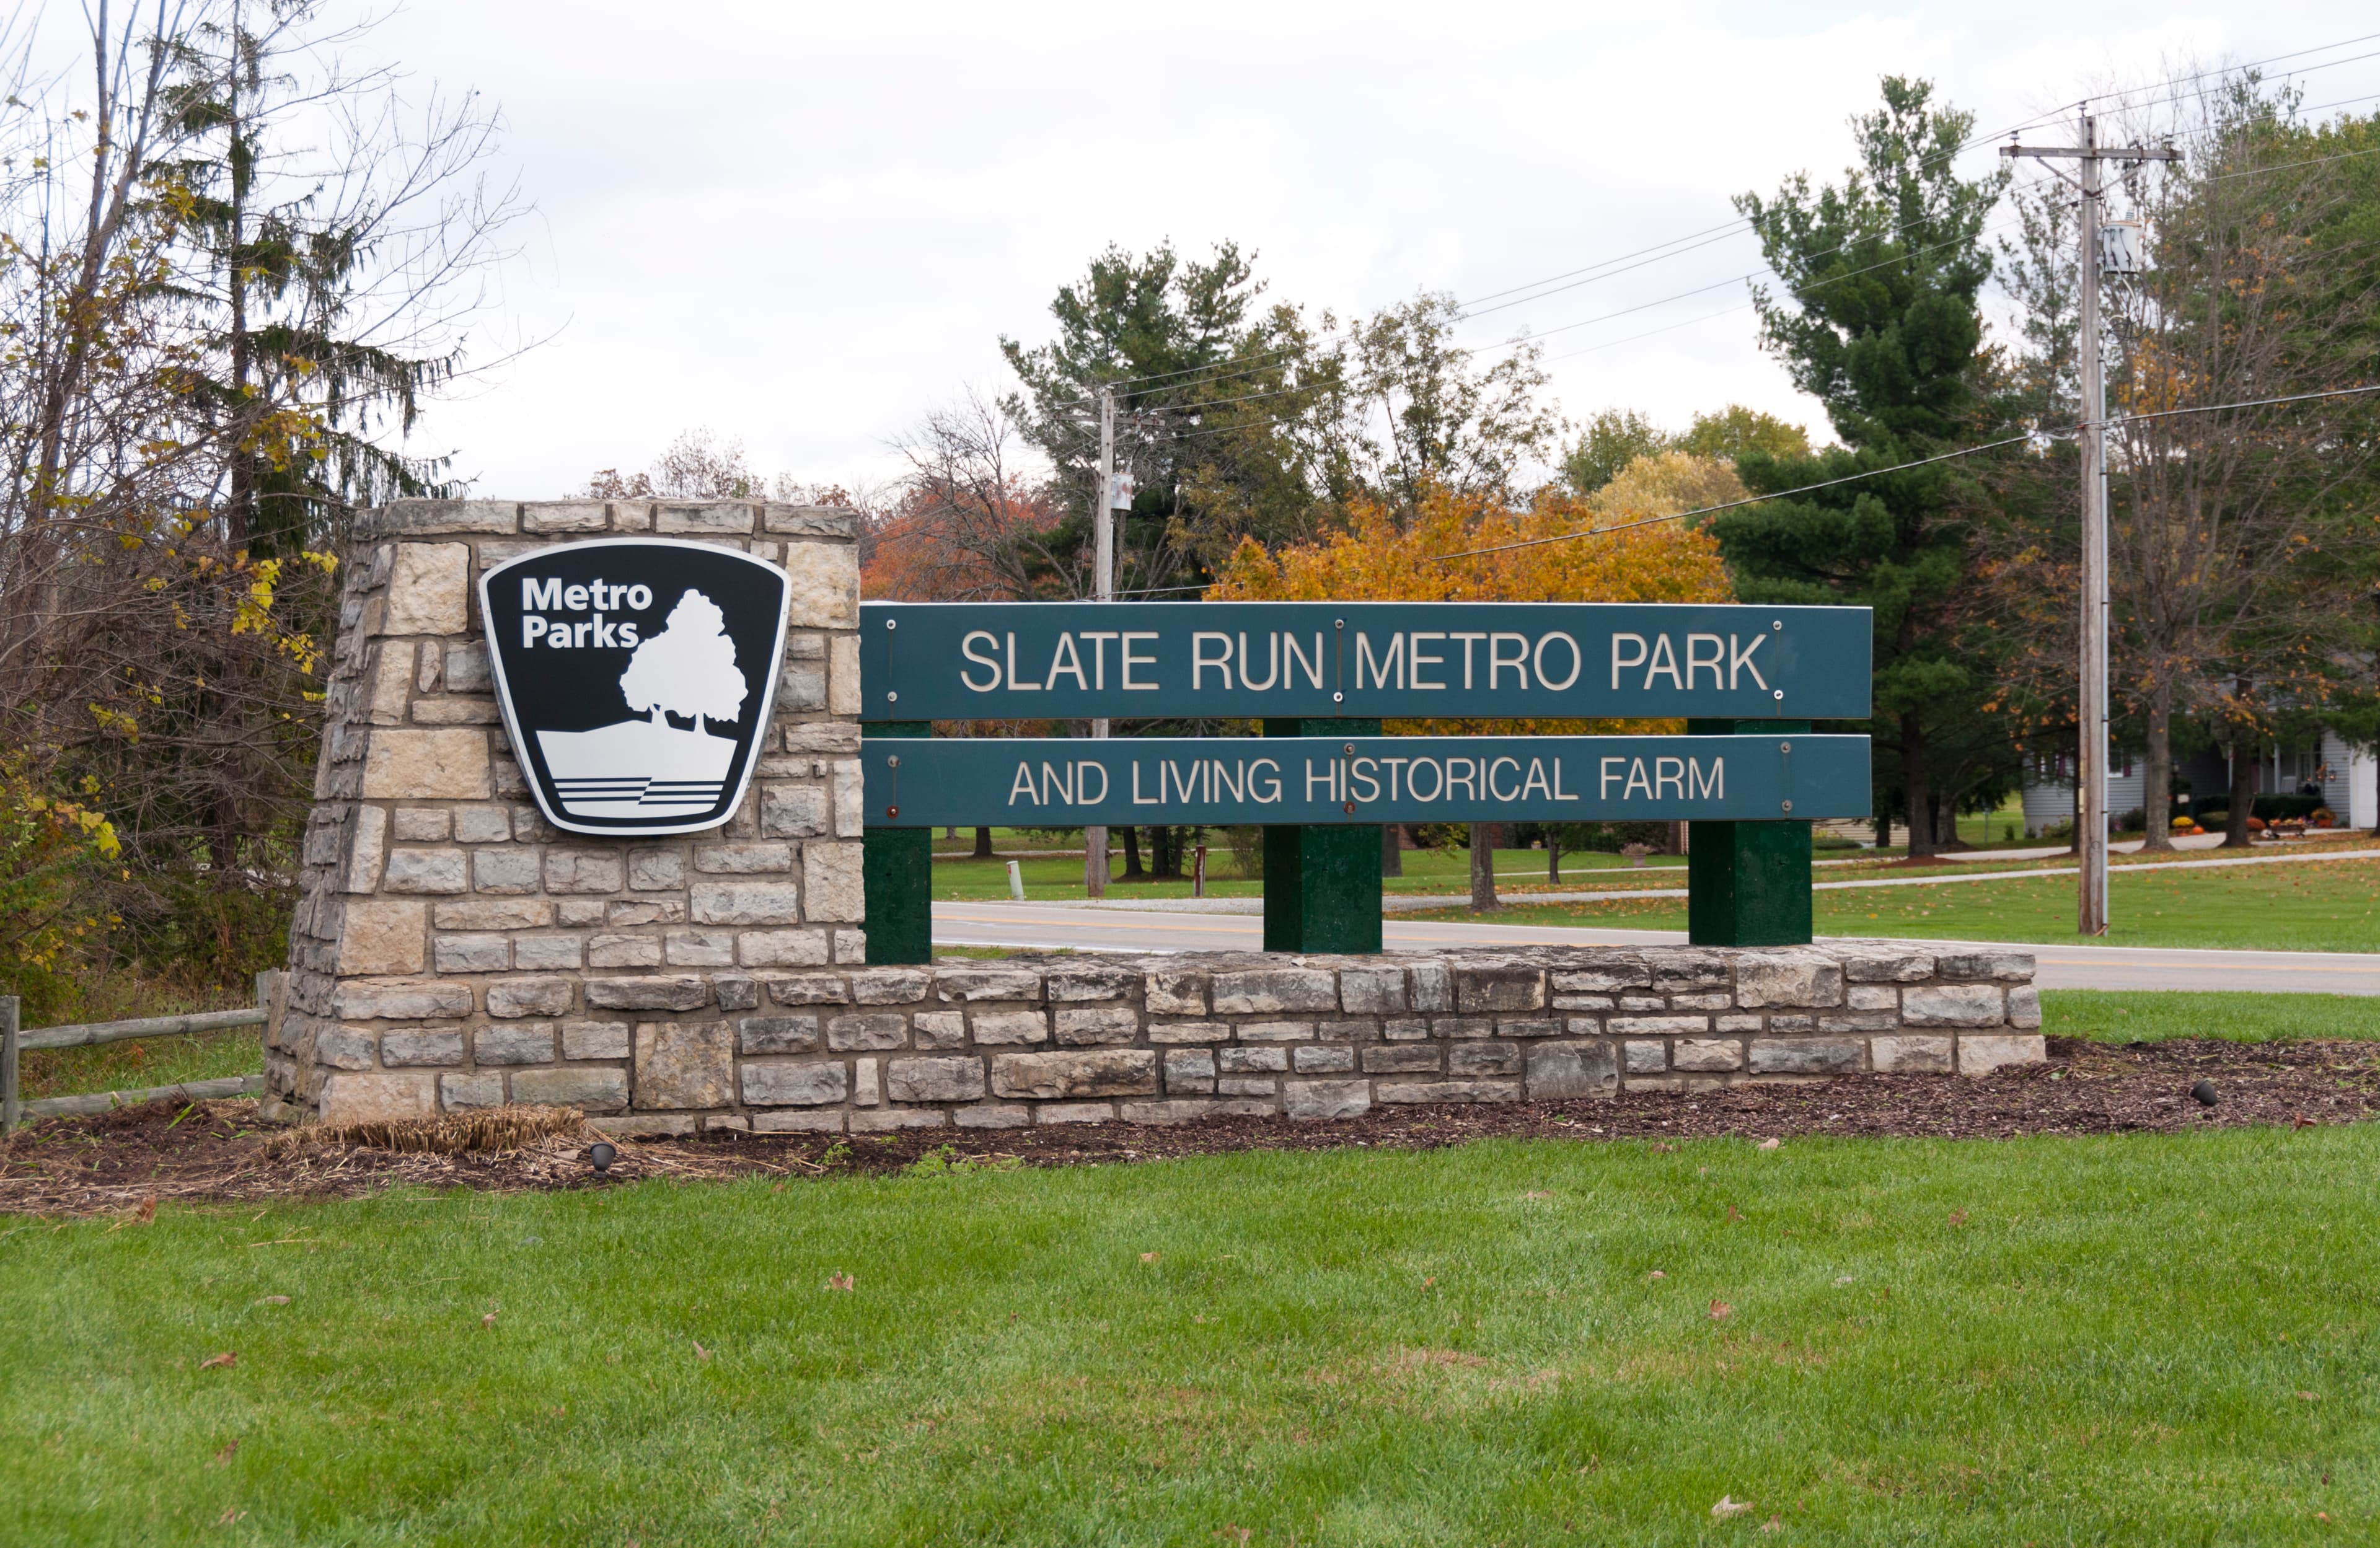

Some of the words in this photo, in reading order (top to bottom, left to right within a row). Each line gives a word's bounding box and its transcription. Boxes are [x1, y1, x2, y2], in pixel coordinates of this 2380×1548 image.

[522, 577, 653, 611] Metro
[522, 613, 640, 649] Parks
[960, 630, 1160, 692] SLATE
[1192, 631, 1323, 691] RUN
[1355, 631, 1582, 691] METRO
[1611, 633, 1768, 690] PARK
[1008, 760, 1109, 806] AND
[1132, 758, 1282, 805] LIVING
[1305, 757, 1579, 803] HISTORICAL
[1600, 757, 1724, 800] FARM
